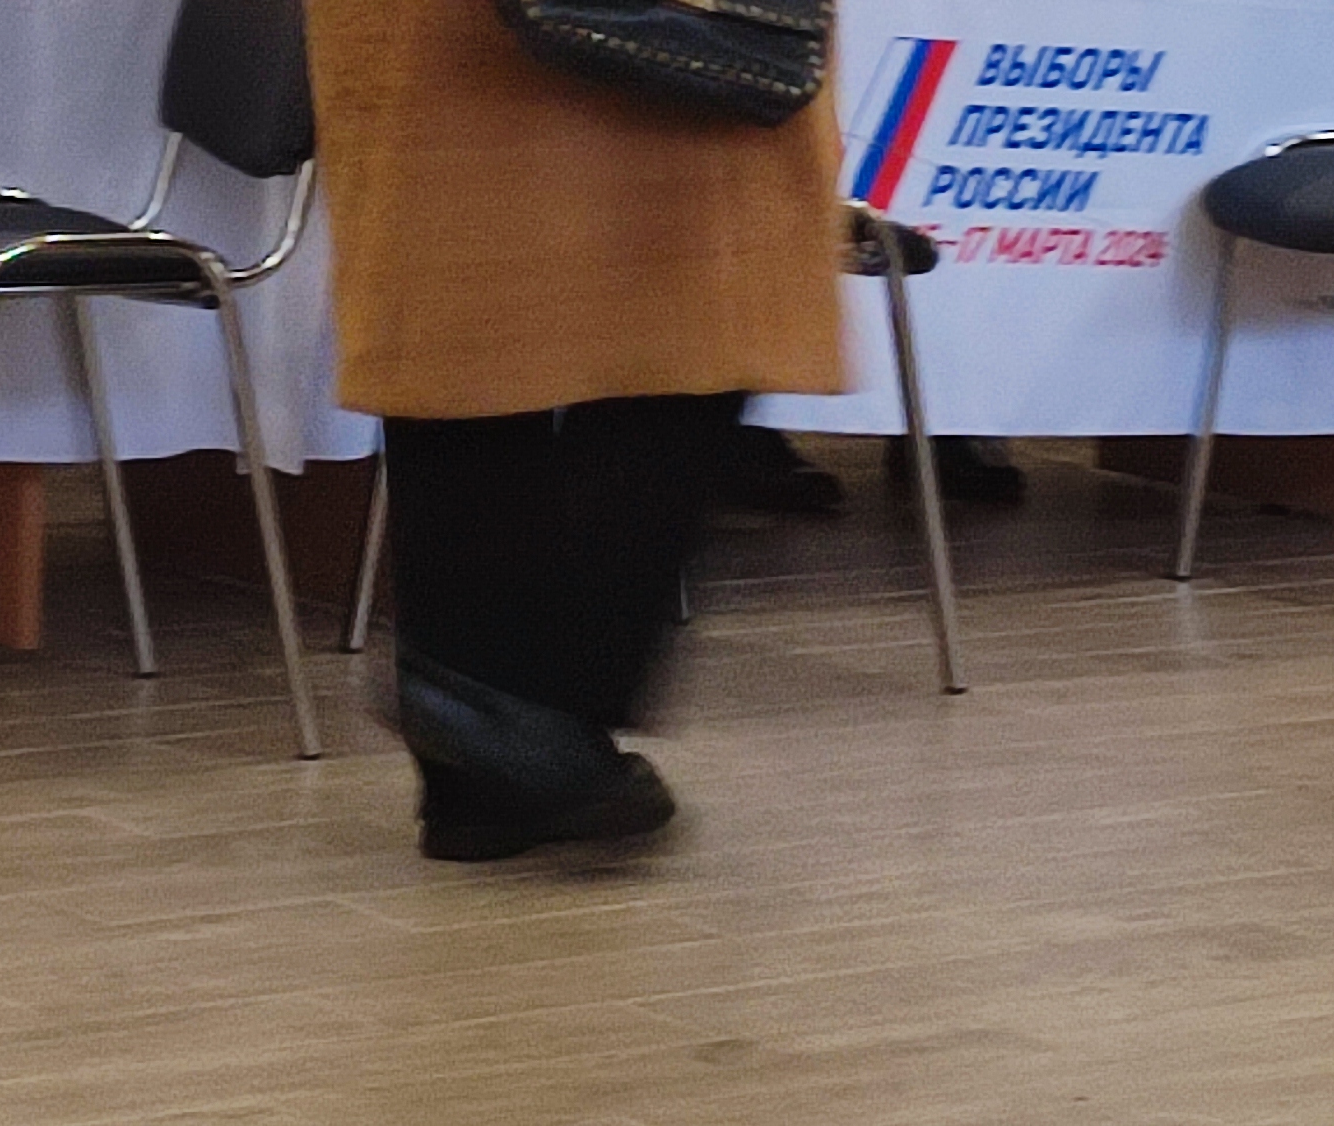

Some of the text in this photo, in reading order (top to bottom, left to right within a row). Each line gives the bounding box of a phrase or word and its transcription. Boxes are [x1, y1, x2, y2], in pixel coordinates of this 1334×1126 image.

[974, 44, 1166, 92] ВЫБОРЫ
[947, 105, 1209, 158] ПРЕЗИДЕНТА
[922, 165, 1102, 212] РОССИИ
[988, 226, 1095, 265] МАРТА
